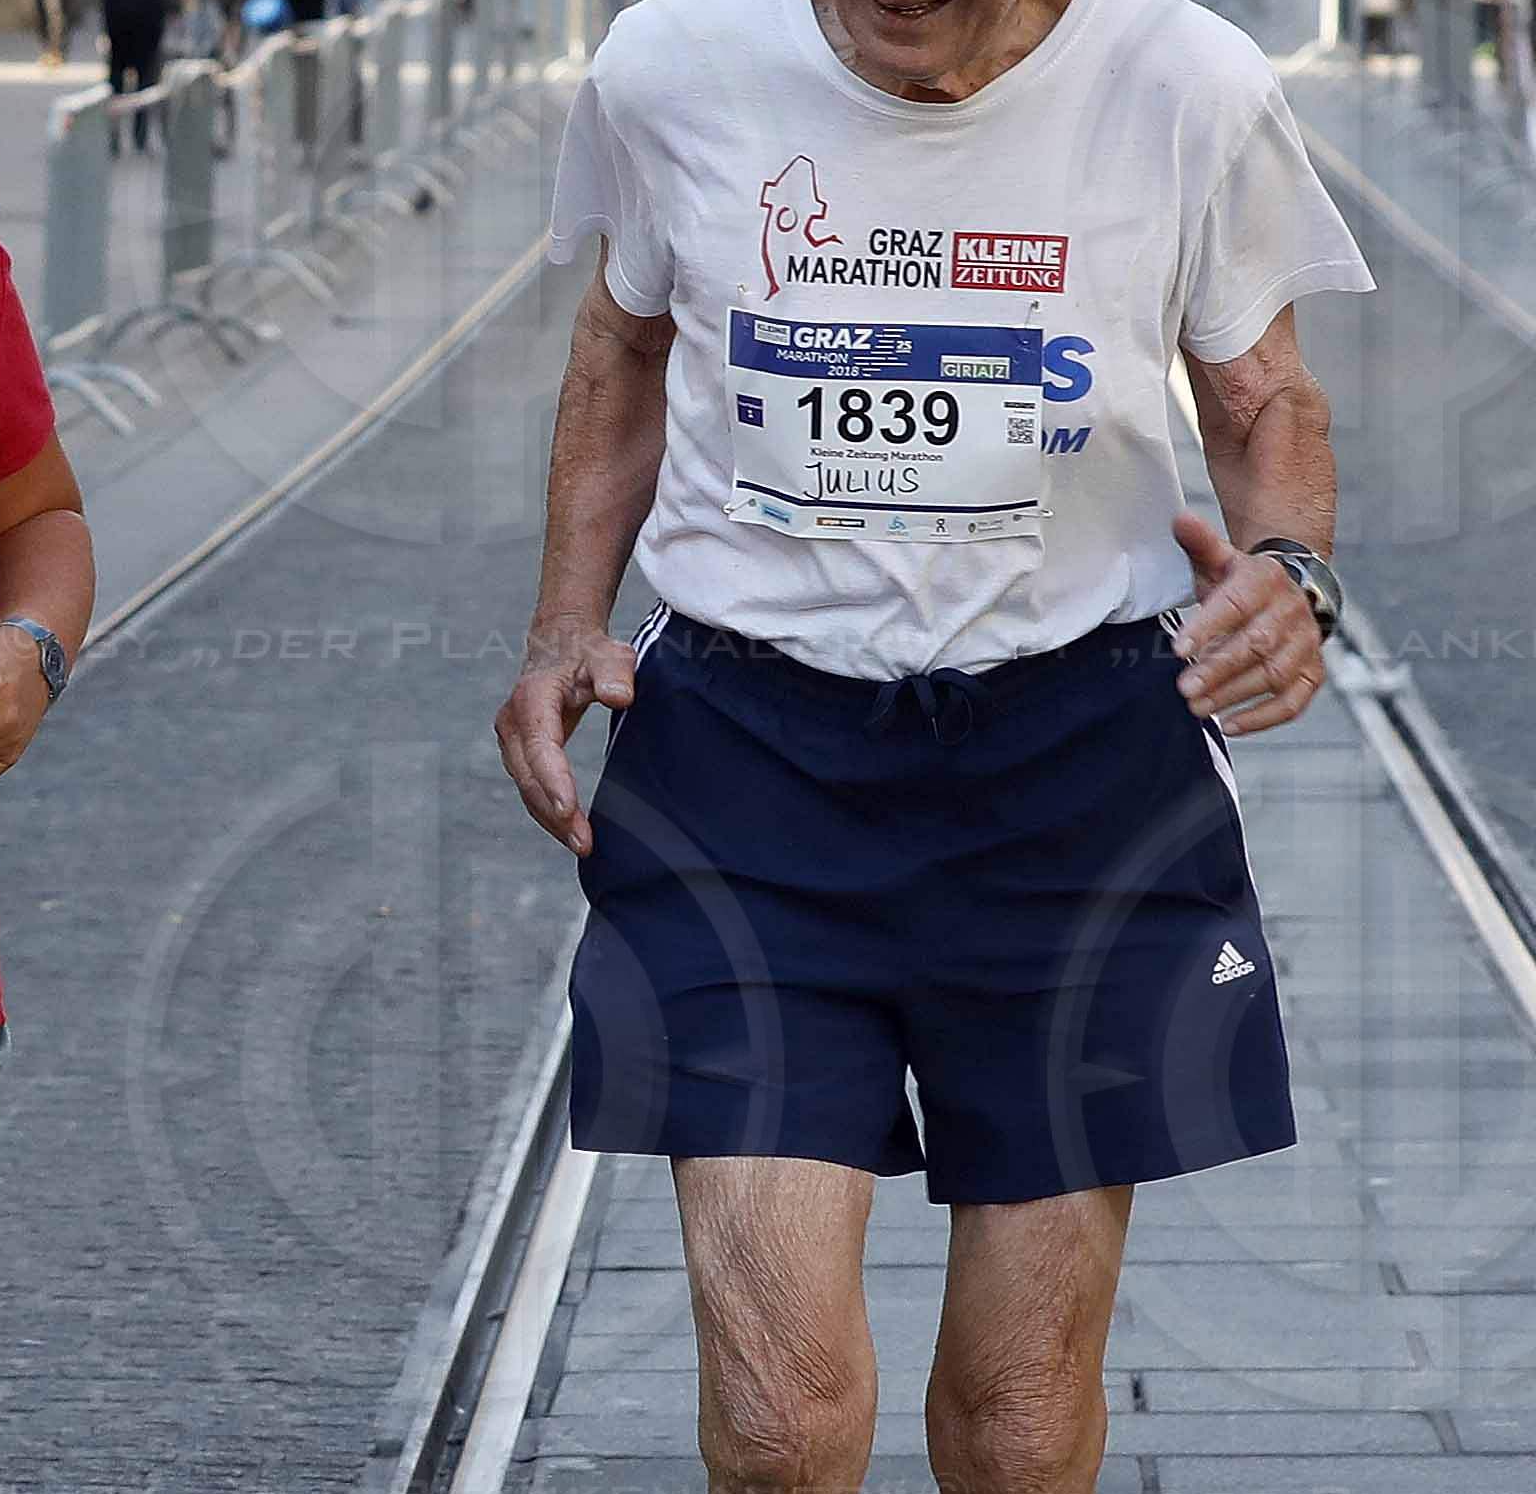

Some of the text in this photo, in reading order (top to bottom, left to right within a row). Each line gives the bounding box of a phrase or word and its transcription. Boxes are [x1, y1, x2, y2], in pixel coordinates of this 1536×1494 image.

[870, 229, 942, 256] GRAZ
[956, 238, 1062, 263] KLEINE
[787, 257, 941, 288] MARATHON
[956, 267, 1060, 287] ZEITUNG
[793, 327, 873, 350] GRAZ
[776, 348, 848, 364] MARATHON
[828, 365, 860, 377] 2018
[943, 364, 1007, 378] GRAZ
[797, 386, 960, 446] 1839
[810, 447, 943, 462] Kleine Zeitung Marathon
[803, 461, 919, 501] JULIUS
[1212, 961, 1255, 984] adidas
